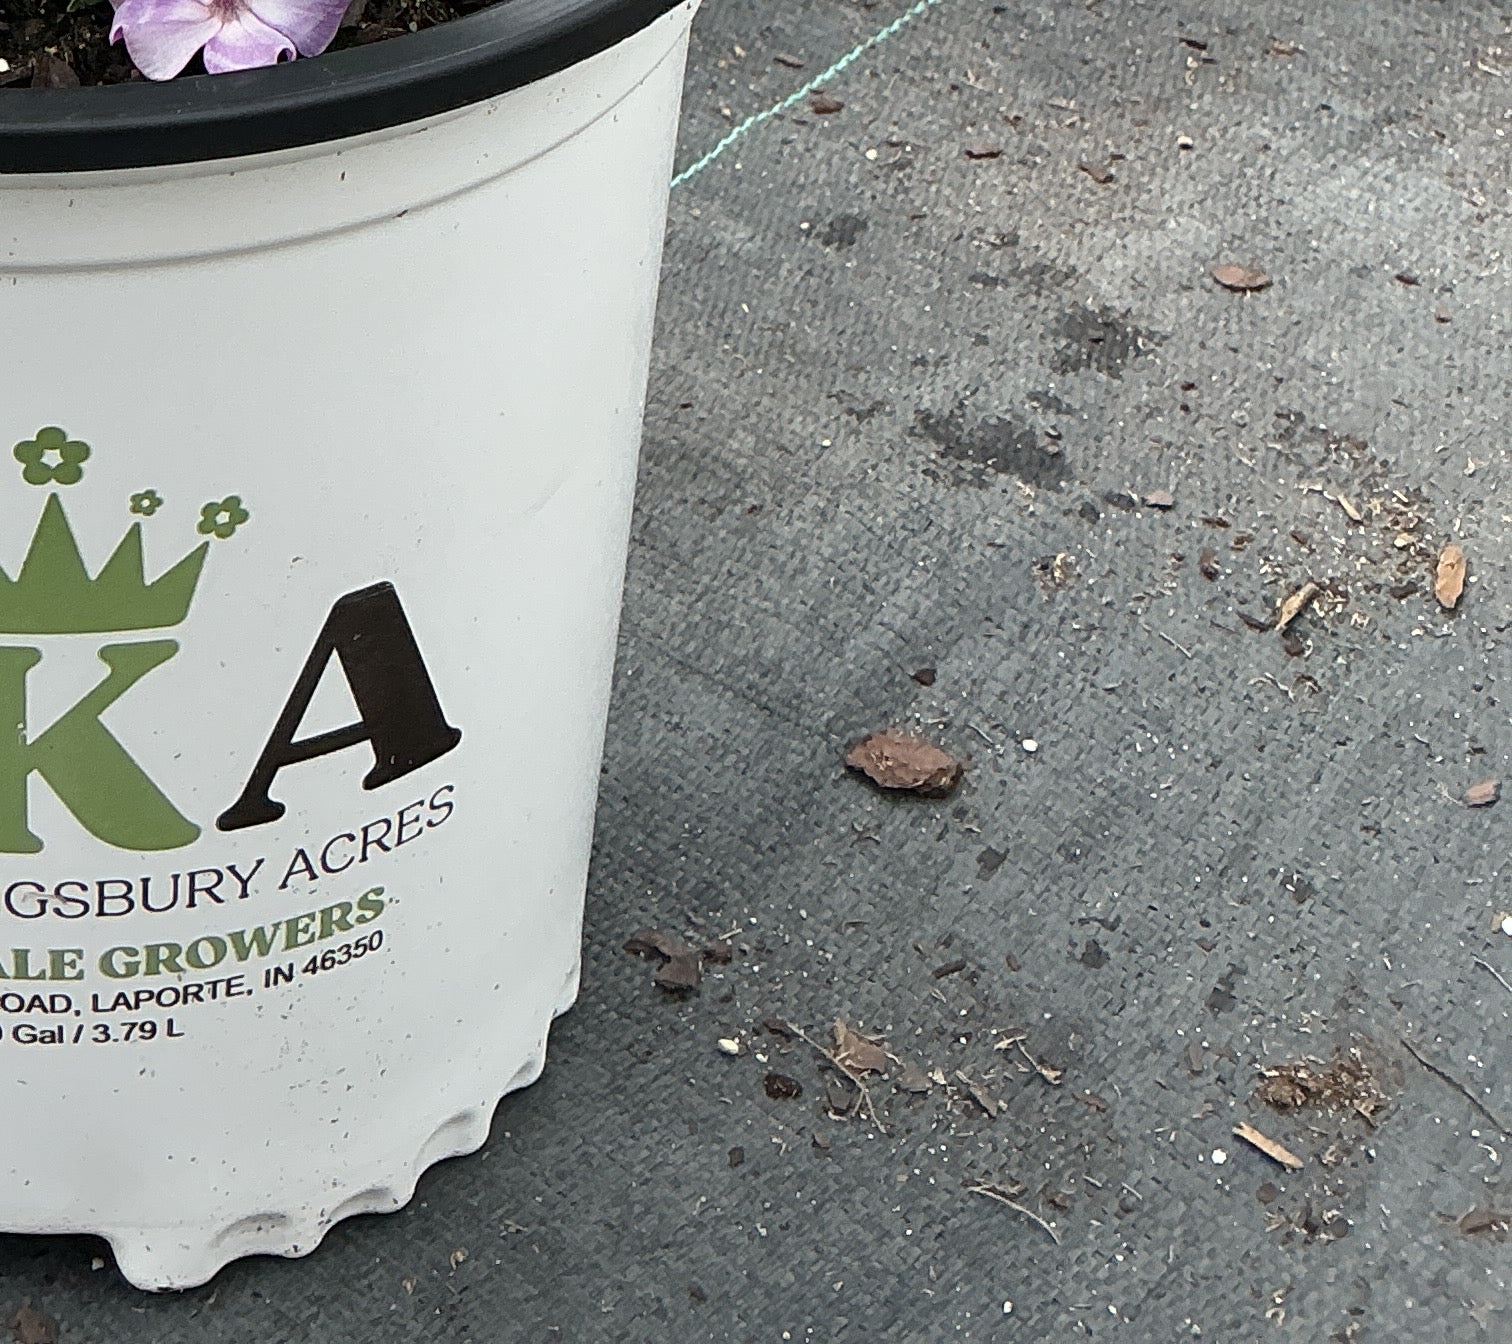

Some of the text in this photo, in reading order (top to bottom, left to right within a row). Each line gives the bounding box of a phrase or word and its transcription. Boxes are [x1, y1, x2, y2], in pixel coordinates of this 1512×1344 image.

[278, 783, 455, 890] ACRES
[91, 975, 253, 1012] LAPORTE,
[263, 962, 295, 989] IN
[302, 928, 384, 976] 46350
[99, 886, 386, 980] GROWERS
[12, 1022, 65, 1045] Gal
[72, 1023, 84, 1045] /
[91, 1021, 158, 1044] 3.79
[166, 1018, 185, 1039] L
